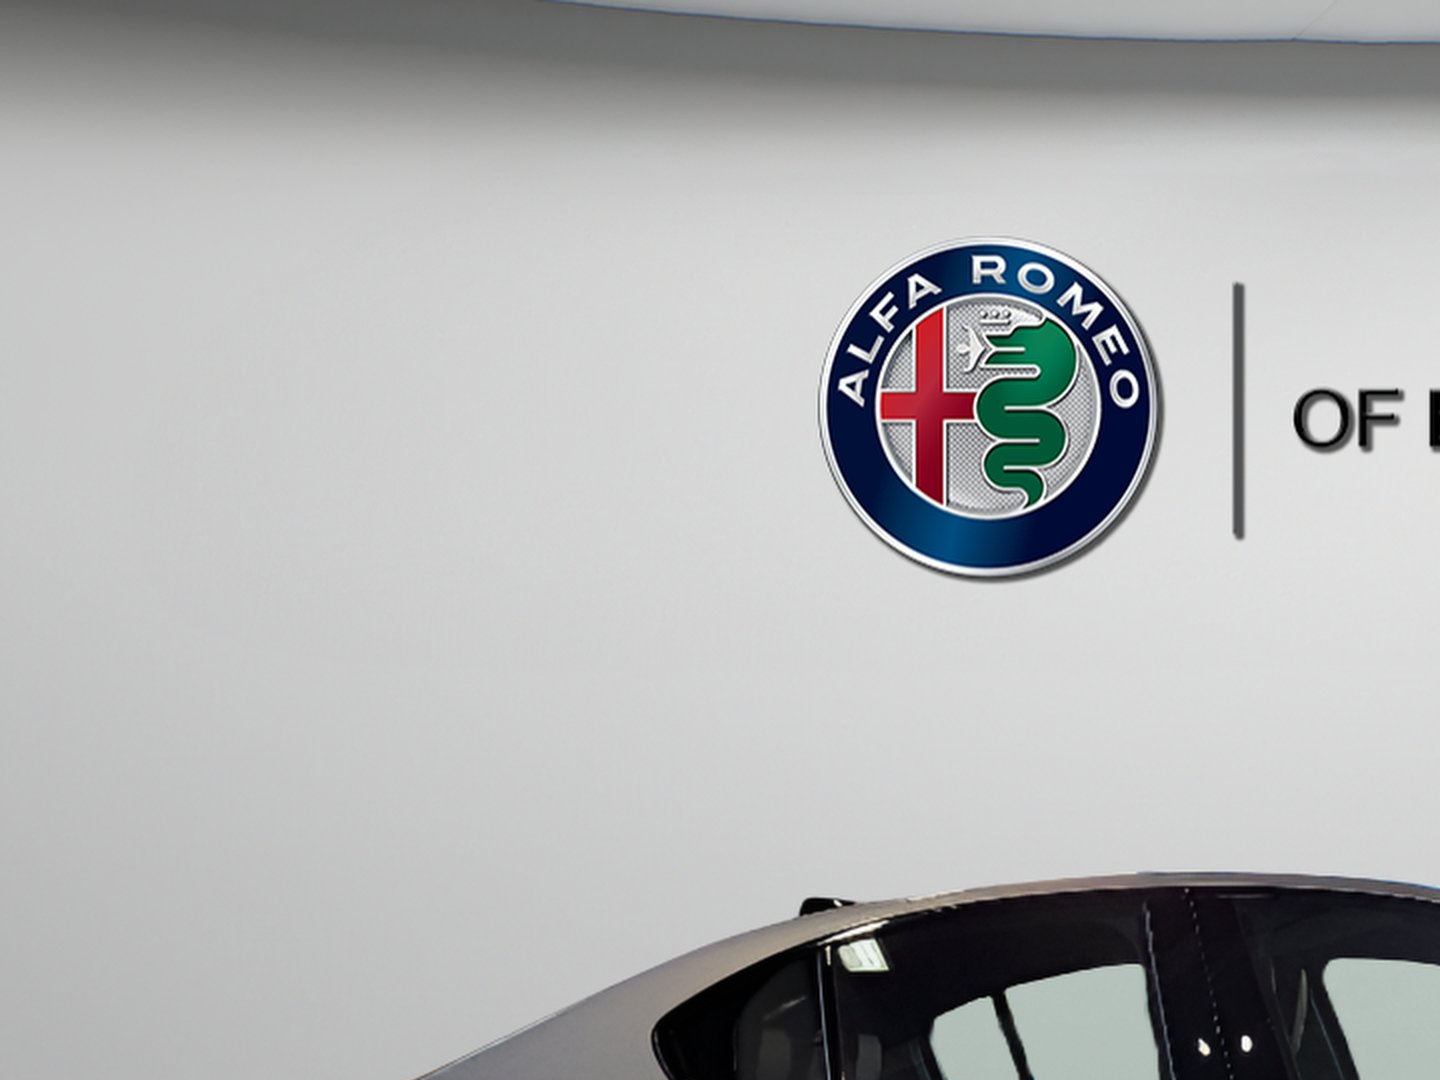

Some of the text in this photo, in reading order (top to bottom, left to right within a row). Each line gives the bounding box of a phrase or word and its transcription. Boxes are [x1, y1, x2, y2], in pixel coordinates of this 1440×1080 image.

[837, 254, 1140, 409] ALFA ROMEO
[1293, 388, 1403, 451] OF
